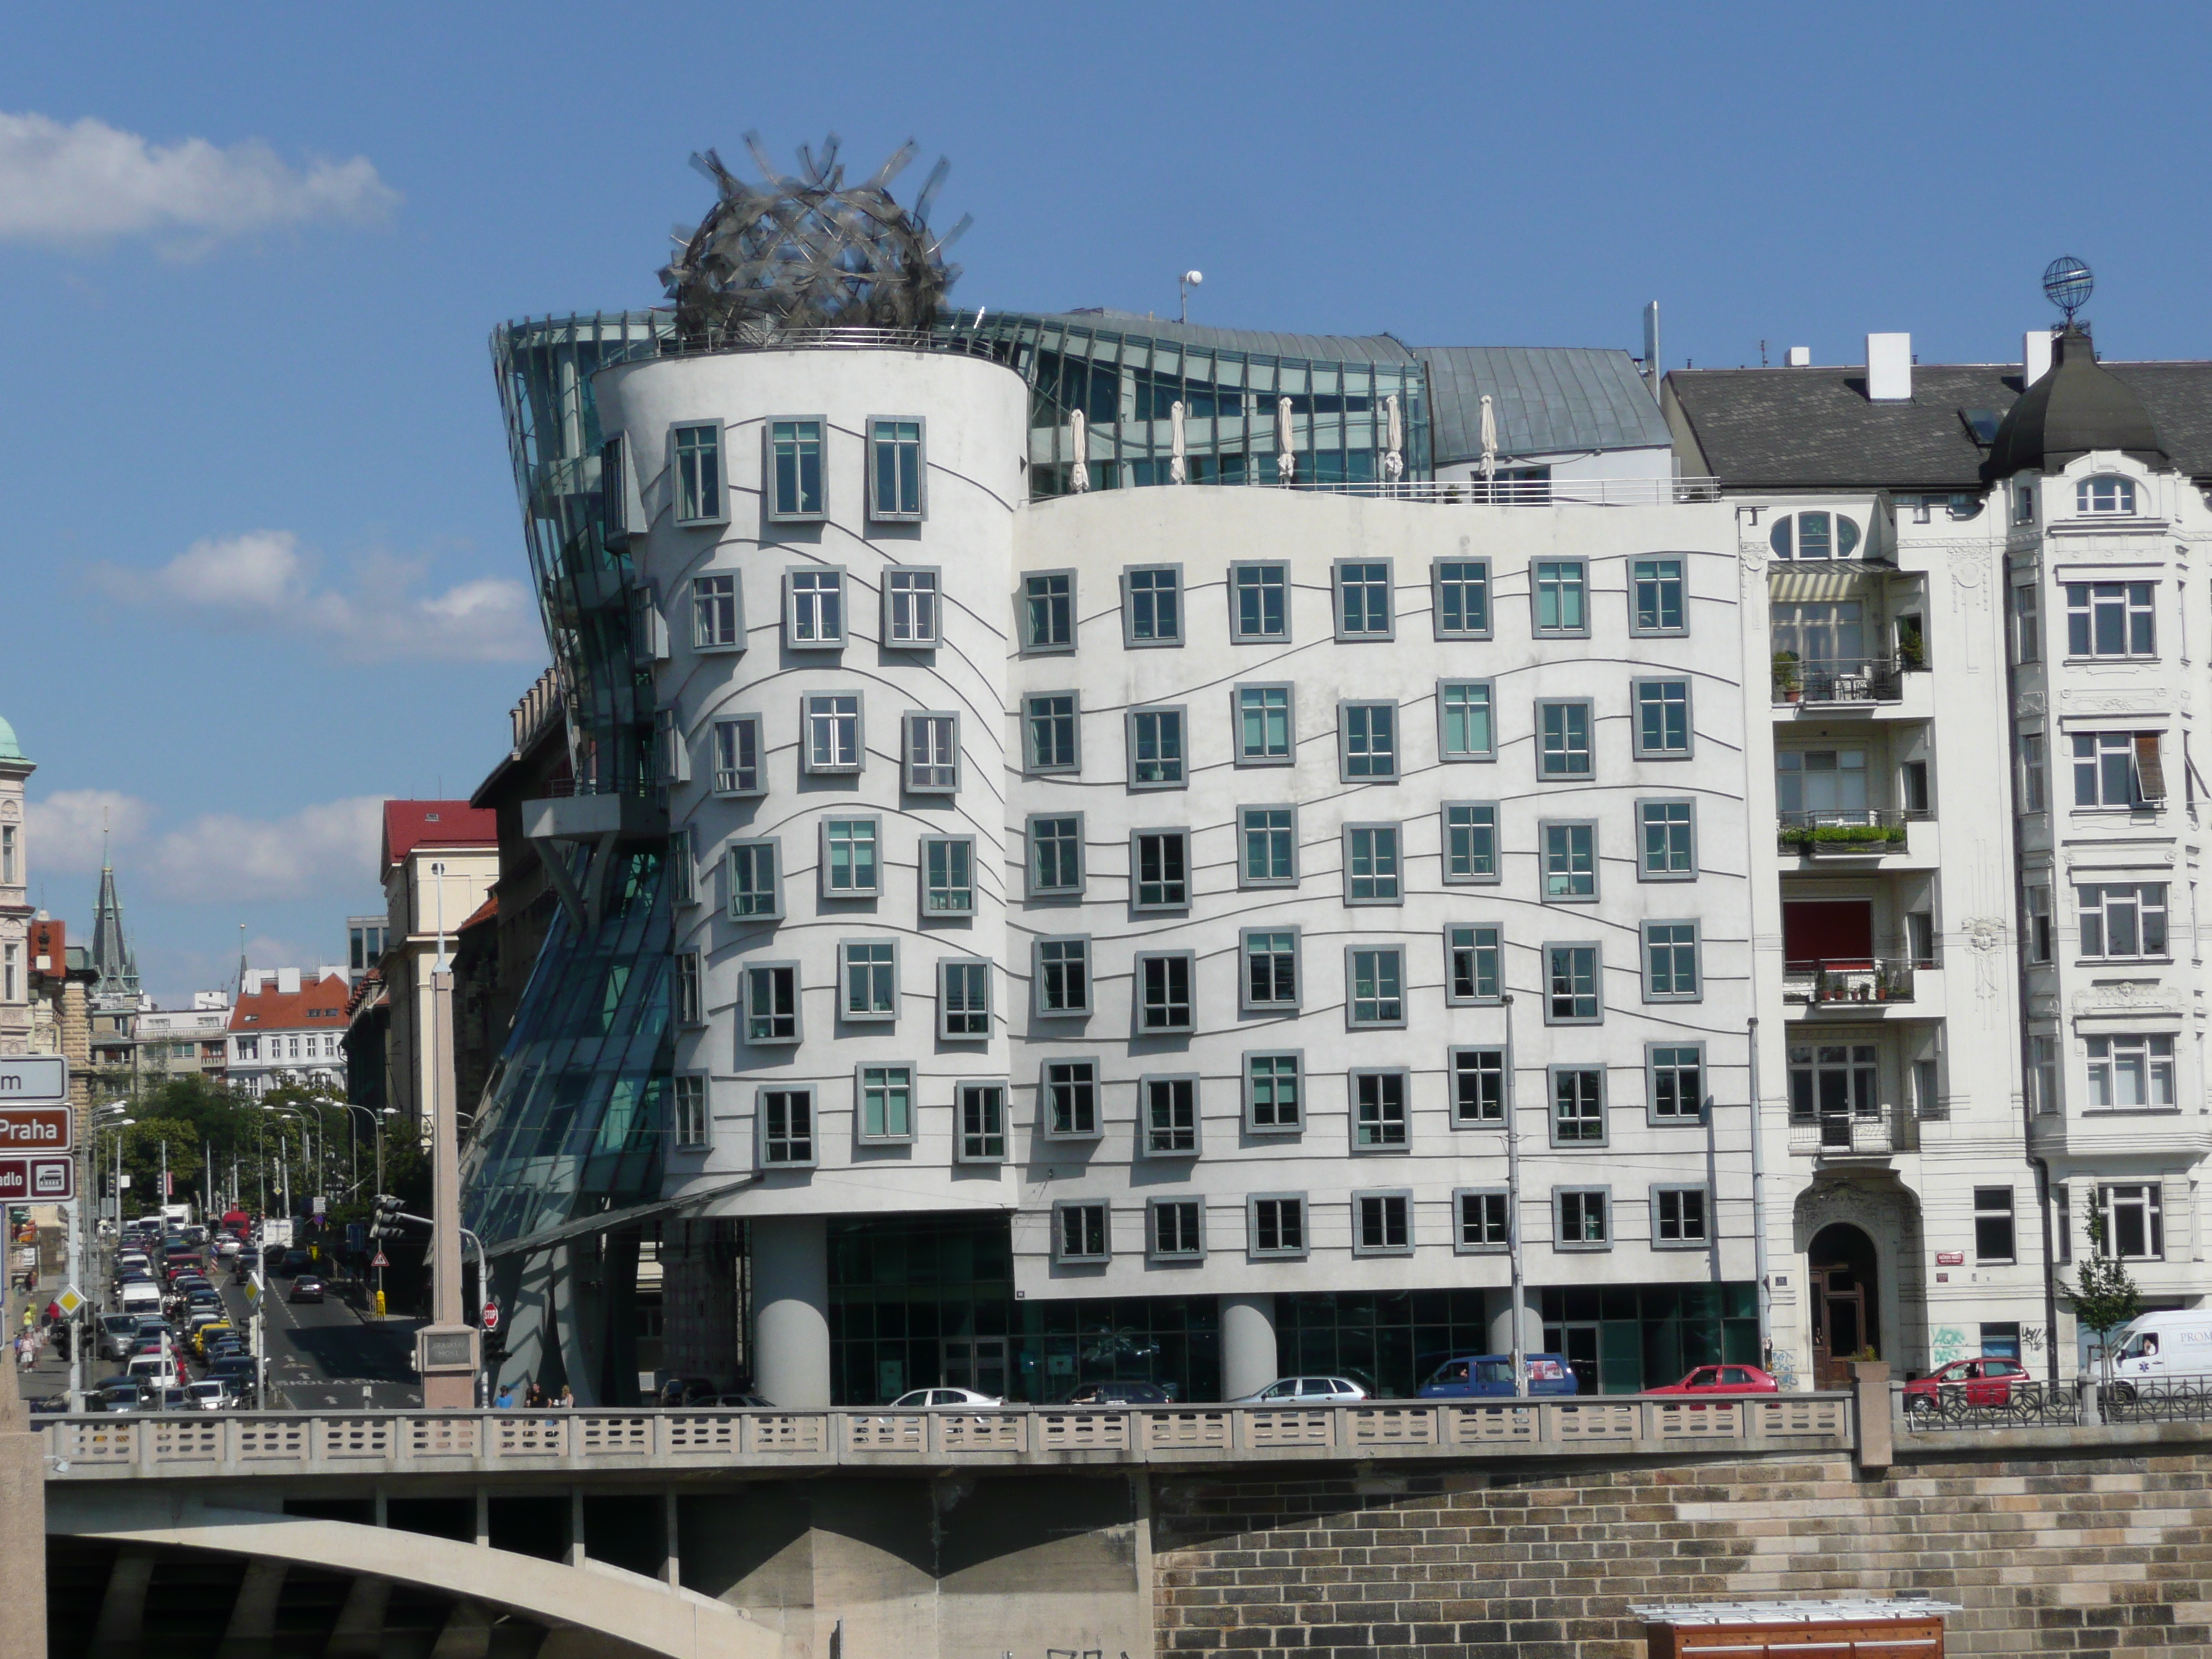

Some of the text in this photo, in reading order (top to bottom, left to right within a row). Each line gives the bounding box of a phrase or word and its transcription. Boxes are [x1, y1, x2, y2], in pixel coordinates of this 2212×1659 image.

[0, 1118, 58, 1140] Praha
[485, 1310, 495, 1319] STOP
[2180, 1331, 2212, 1342] PROM
